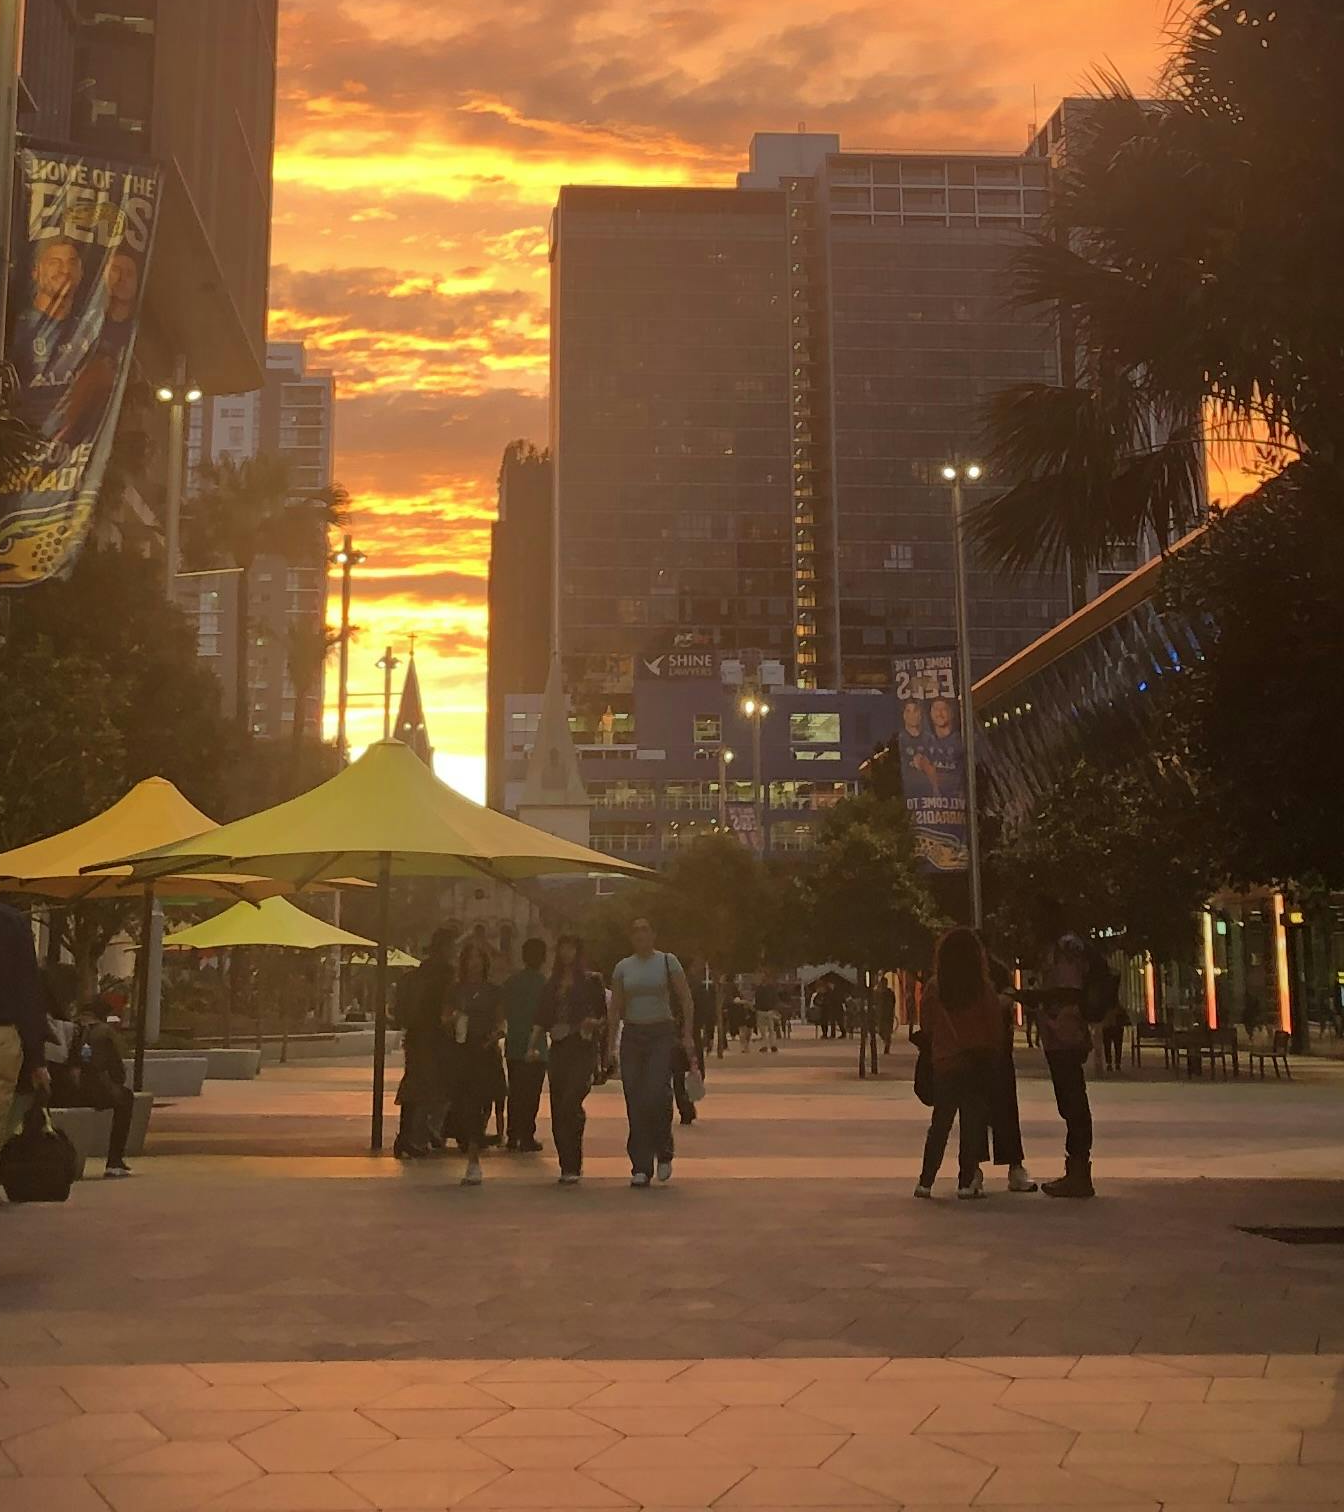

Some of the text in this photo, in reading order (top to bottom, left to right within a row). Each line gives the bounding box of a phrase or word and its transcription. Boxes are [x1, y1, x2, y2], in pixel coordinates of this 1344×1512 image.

[92, 169, 117, 189] OF
[120, 174, 157, 198] THE
[27, 182, 154, 253] EELS
[668, 654, 713, 667] SHINE
[668, 667, 713, 677] LAWYERS
